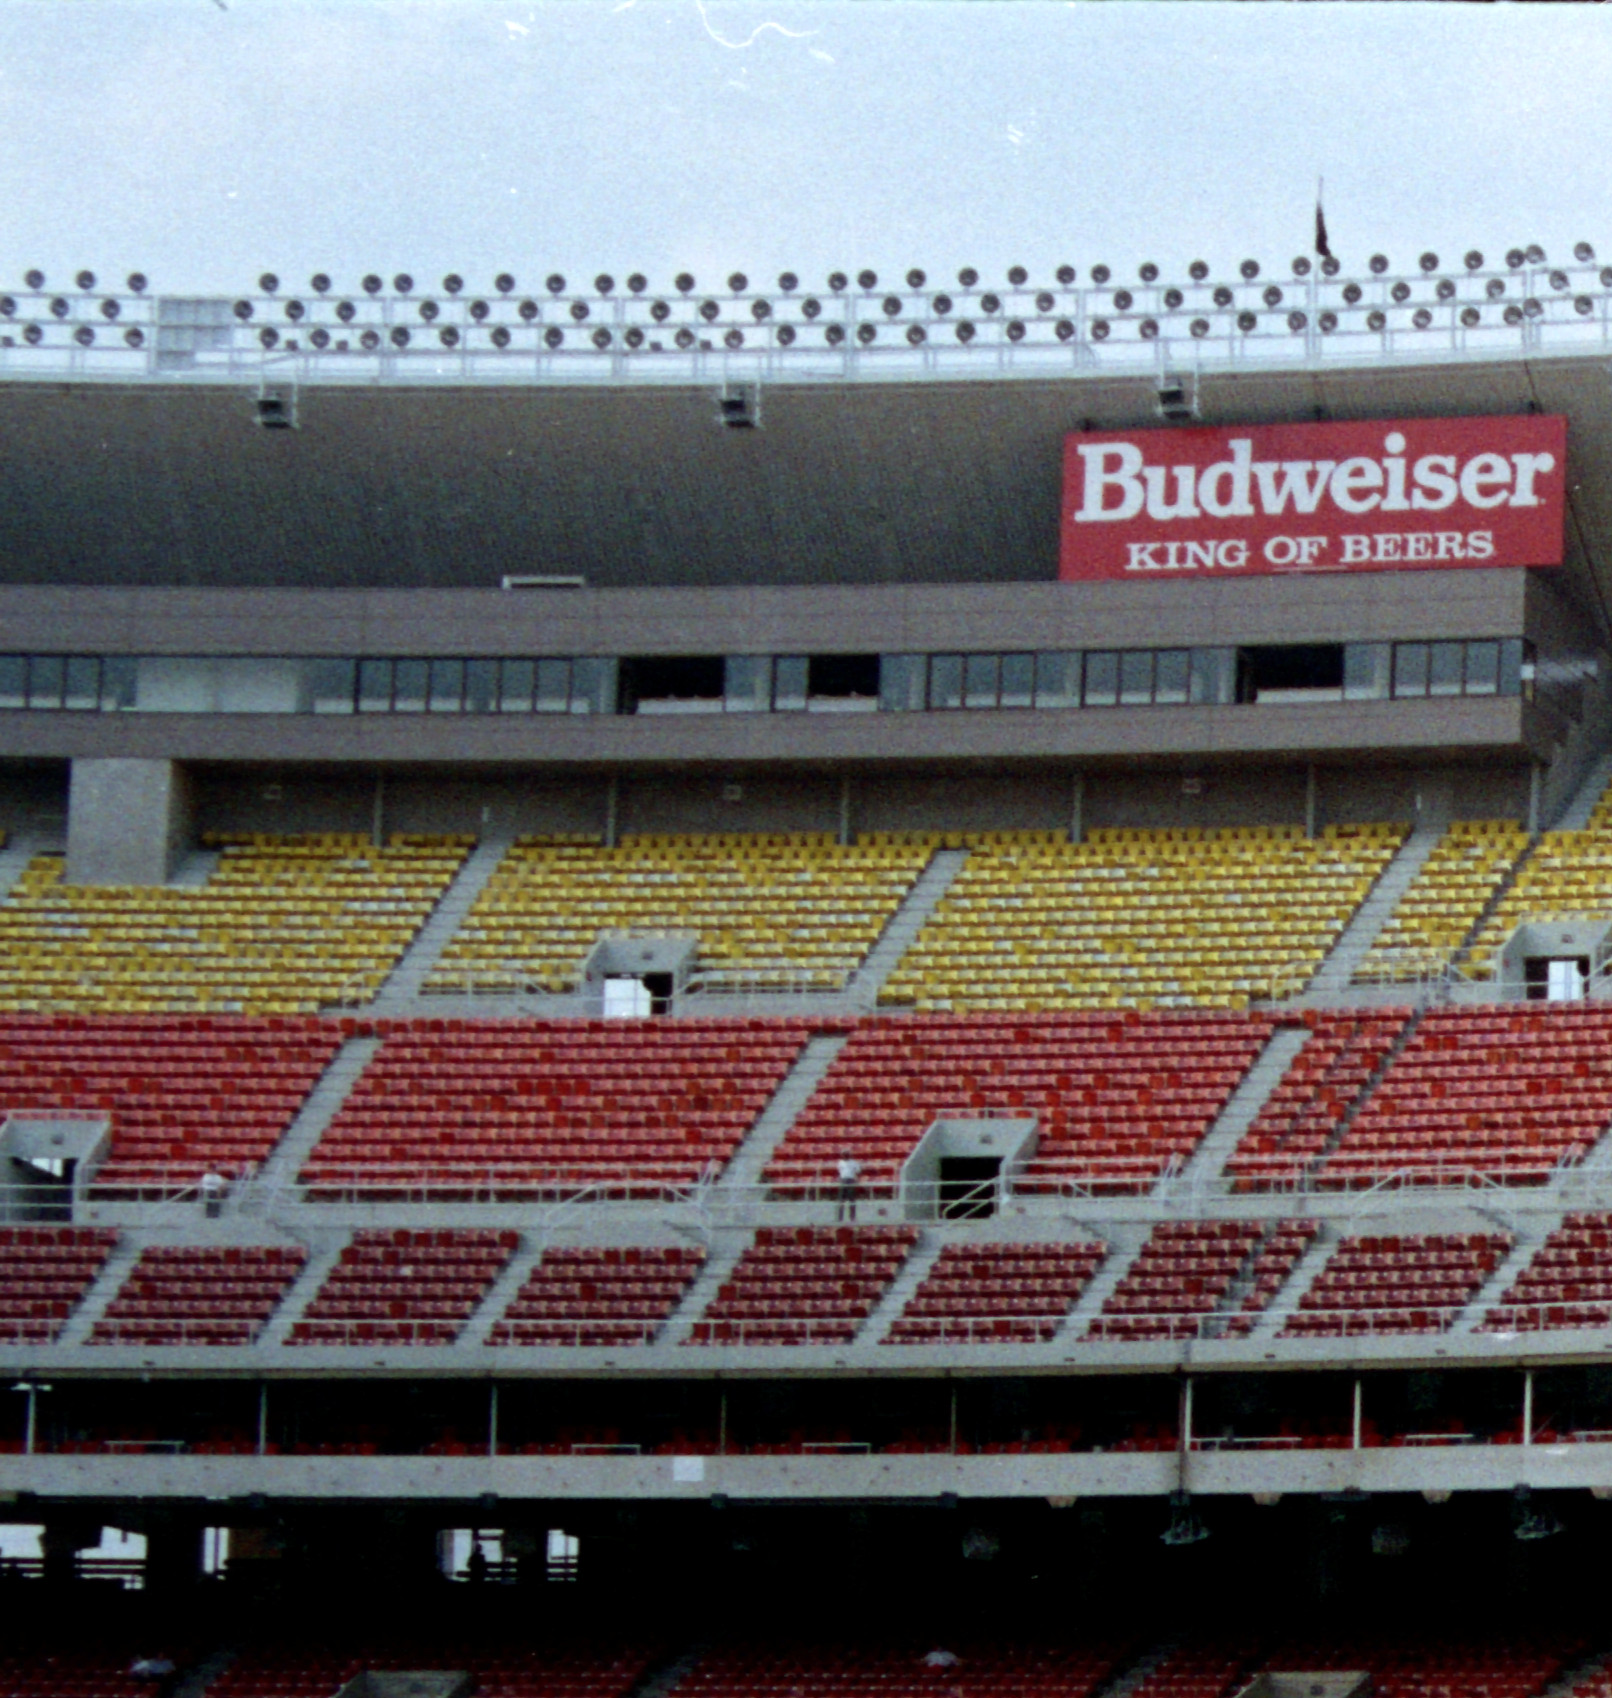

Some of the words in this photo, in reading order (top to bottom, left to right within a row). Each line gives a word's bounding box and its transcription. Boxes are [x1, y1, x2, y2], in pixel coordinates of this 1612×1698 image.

[1074, 432, 1555, 523] Budweiser
[1124, 540, 1250, 571] KING
[1263, 535, 1328, 566] OF
[1341, 530, 1495, 563] BEERS
